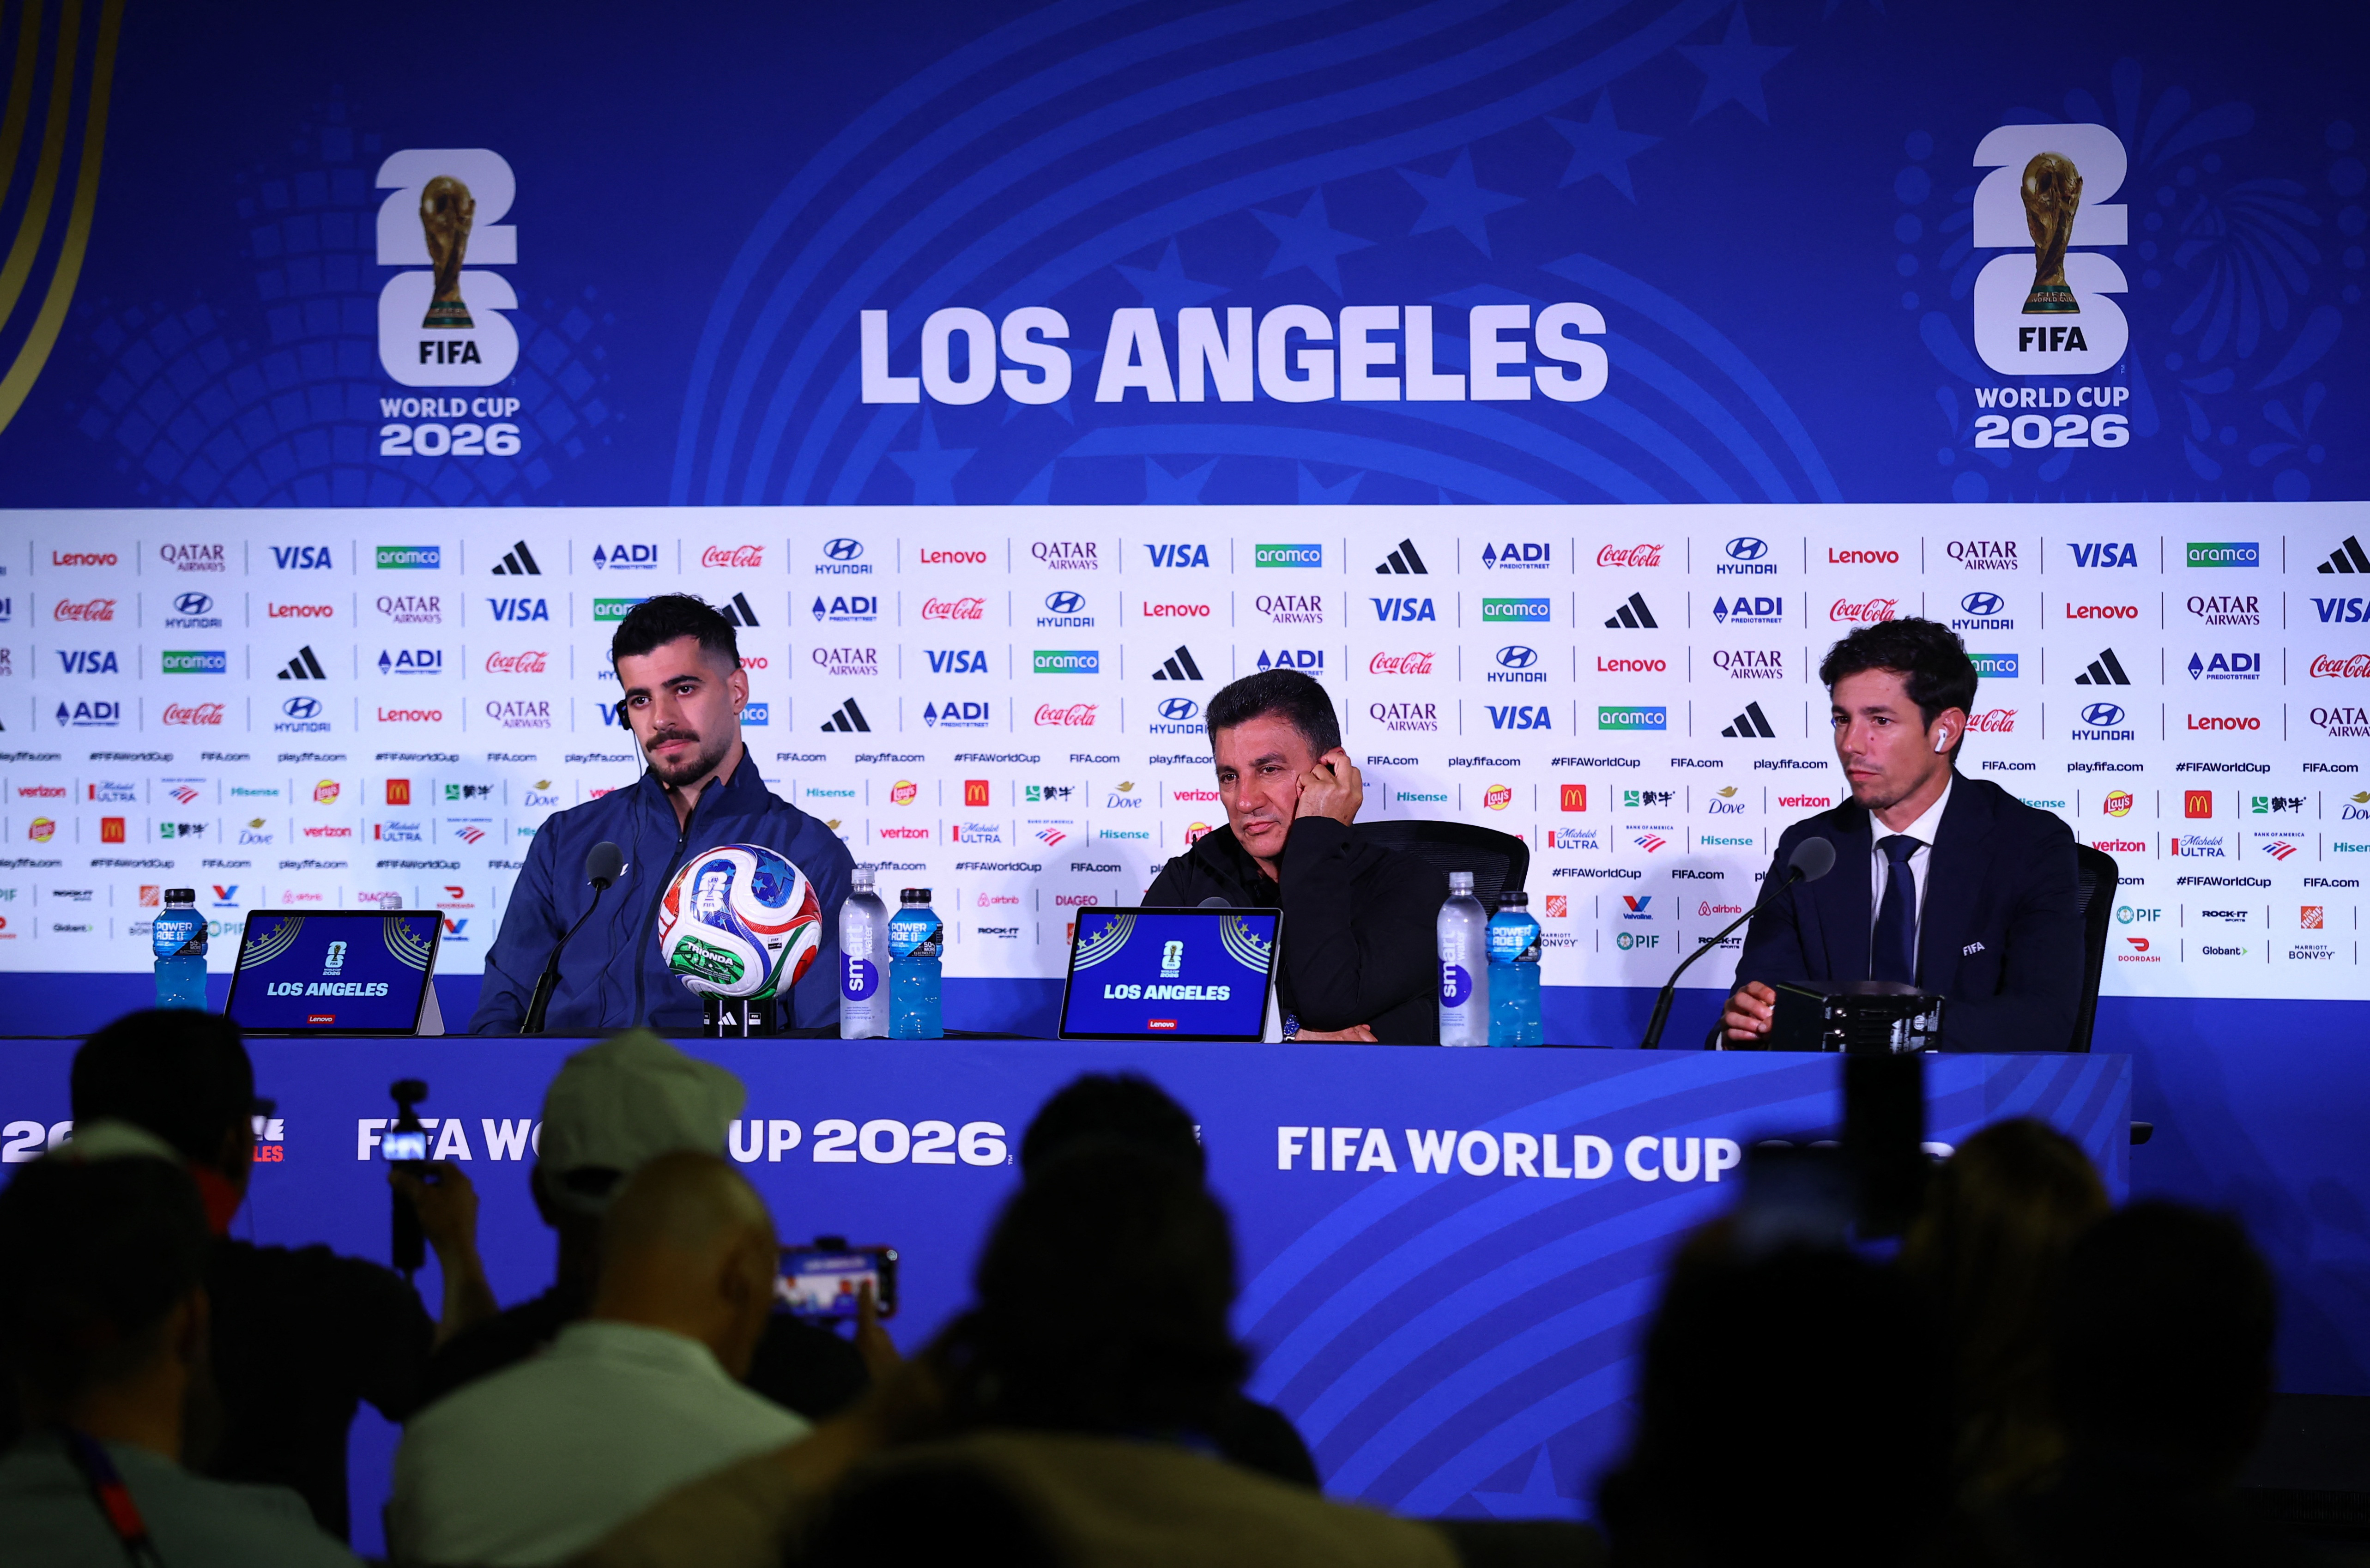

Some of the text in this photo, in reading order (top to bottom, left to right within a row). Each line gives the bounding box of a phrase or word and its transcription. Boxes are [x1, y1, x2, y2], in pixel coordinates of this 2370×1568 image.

[2019, 327, 2087, 351] FIFA
[420, 341, 481, 364] FIFA
[861, 303, 1608, 405] LOS ANGELES
[1975, 387, 2129, 408] WORLD CUP
[380, 398, 520, 418] WORLD CUP
[1975, 414, 2129, 448] 2026
[381, 423, 521, 456] 2026
[269, 546, 332, 569] VISA
[611, 545, 657, 562] ADI
[701, 545, 765, 568] Coca-Cola
[921, 548, 986, 563] Lenovo
[1032, 542, 1097, 562] QATAR
[1144, 544, 1209, 567] VISA
[1258, 551, 1320, 561] aramco
[1500, 543, 1550, 561] ADI
[1597, 544, 1664, 567] Coca-Cola
[1829, 548, 1899, 563] Lenovo
[1947, 541, 2017, 561] QATAR
[2067, 543, 2137, 567] VISA
[2189, 549, 2256, 560] aramco
[53, 550, 117, 566] Lenovo
[1048, 560, 1098, 569] AIRWAYS
[1965, 560, 2018, 569] AIRWAYS
[816, 564, 872, 574] HYUNDAI
[1717, 564, 1777, 574] HYUNDAI
[922, 598, 986, 620] Coca-Cola
[1144, 601, 1210, 617] Lenovo
[1256, 596, 1322, 615] QATAR
[1369, 598, 1436, 621] VISA
[1485, 605, 1548, 615] aramco
[1732, 597, 1782, 615] ADI
[1830, 599, 1899, 621] Coca-Cola
[2067, 603, 2138, 618] Lenovo
[2187, 596, 2259, 616] QATAR
[1037, 618, 1094, 627] HYUNDAI
[1273, 613, 1323, 624] AIRWAYS
[1953, 619, 2013, 630] HYUNDAI
[2206, 615, 2259, 625] AIRWAYS
[396, 650, 441, 667] ADI
[924, 650, 988, 673] VISA
[1035, 657, 1097, 667] aramco
[1275, 650, 1324, 668] ADI
[1369, 652, 1435, 674] Coca-Cola
[1598, 656, 1666, 672] Lenovo
[1713, 651, 1782, 670] QATAR
[2207, 653, 2260, 672] ADI
[1488, 672, 1546, 682] HYUNDAI
[1731, 669, 1783, 678] AIRWAYS
[163, 703, 225, 726] Coca-Cola
[941, 702, 989, 720] ADI
[1034, 704, 1098, 726] Coca-Cola
[1370, 703, 1436, 722] QATAR
[1484, 706, 1551, 729] VISA
[1601, 713, 1664, 724] aramco
[2188, 714, 2260, 730] Lenovo
[1387, 721, 1437, 731] AIRWAYS
[2073, 730, 2134, 740] HYUNDAI
[777, 753, 826, 762] FIFA.com
[855, 753, 925, 763] play.fifa.com
[954, 753, 1040, 764] #FIFAWorldCup
[1070, 754, 1120, 763] FIFA.com
[1367, 757, 1418, 765] FIFA.com
[1449, 757, 1520, 767] play.fifa.com
[1551, 757, 1640, 769] #FIFAWorldCup
[1671, 758, 1723, 767] FIFA.com
[1754, 759, 1827, 770] play.fifa.com
[1983, 762, 2036, 770] FIFA.com
[2068, 762, 2143, 773] play.fifa.com
[2176, 763, 2270, 774] #FIFAWorldCup
[2303, 763, 2358, 772] FIFA.com
[806, 788, 855, 797] Hisense
[1397, 792, 1447, 802] Hisense
[1487, 789, 1509, 805] Lay's
[1107, 793, 1142, 808] Dove
[1709, 799, 1745, 814] Dove
[1778, 794, 1830, 807] verizon
[2107, 795, 2130, 812] Lay's
[880, 826, 929, 839] verizon
[961, 834, 1001, 843] ULTRA
[1100, 829, 1149, 839] Hisense
[1557, 828, 1596, 838] Michelob
[1557, 840, 1599, 849] ULTRA
[1701, 835, 1753, 845] Hisense
[2092, 838, 2146, 851] verizon
[2181, 835, 2223, 846] Michelob
[2181, 848, 2225, 857] ULTRA
[955, 862, 1042, 873] #FIFAWorldCup
[1071, 863, 1121, 872] FIFA.com
[1552, 868, 1641, 880] #FIFAWorldCup
[1672, 870, 1724, 879] FIFA.com
[2177, 877, 2271, 888] #FIFAWorldCup
[2304, 878, 2359, 887] FIFA.com
[991, 896, 1019, 904] airbnb
[1056, 896, 1098, 906] DIAGEO
[1712, 904, 1741, 913] airbnb
[2137, 909, 2161, 921] PIF
[157, 922, 192, 931] POWER
[891, 923, 927, 932] POWER
[1493, 927, 1531, 937] POWER
[891, 932, 909, 941] ADE
[1636, 935, 1659, 948] PIF
[687, 942, 733, 965] TRIONDA
[1963, 941, 1985, 956] FIFA
[2202, 946, 2241, 955] Globant
[2289, 951, 2331, 959] BONVOY
[847, 924, 864, 991] smart
[1443, 929, 1457, 997] smart
[267, 983, 388, 996] LOS ANGELES
[1104, 984, 1230, 1001] LOS ANGELES
[729, 1120, 1006, 1166] UP 2026
[1278, 1127, 1740, 1182] FIFA WORLD CUP
